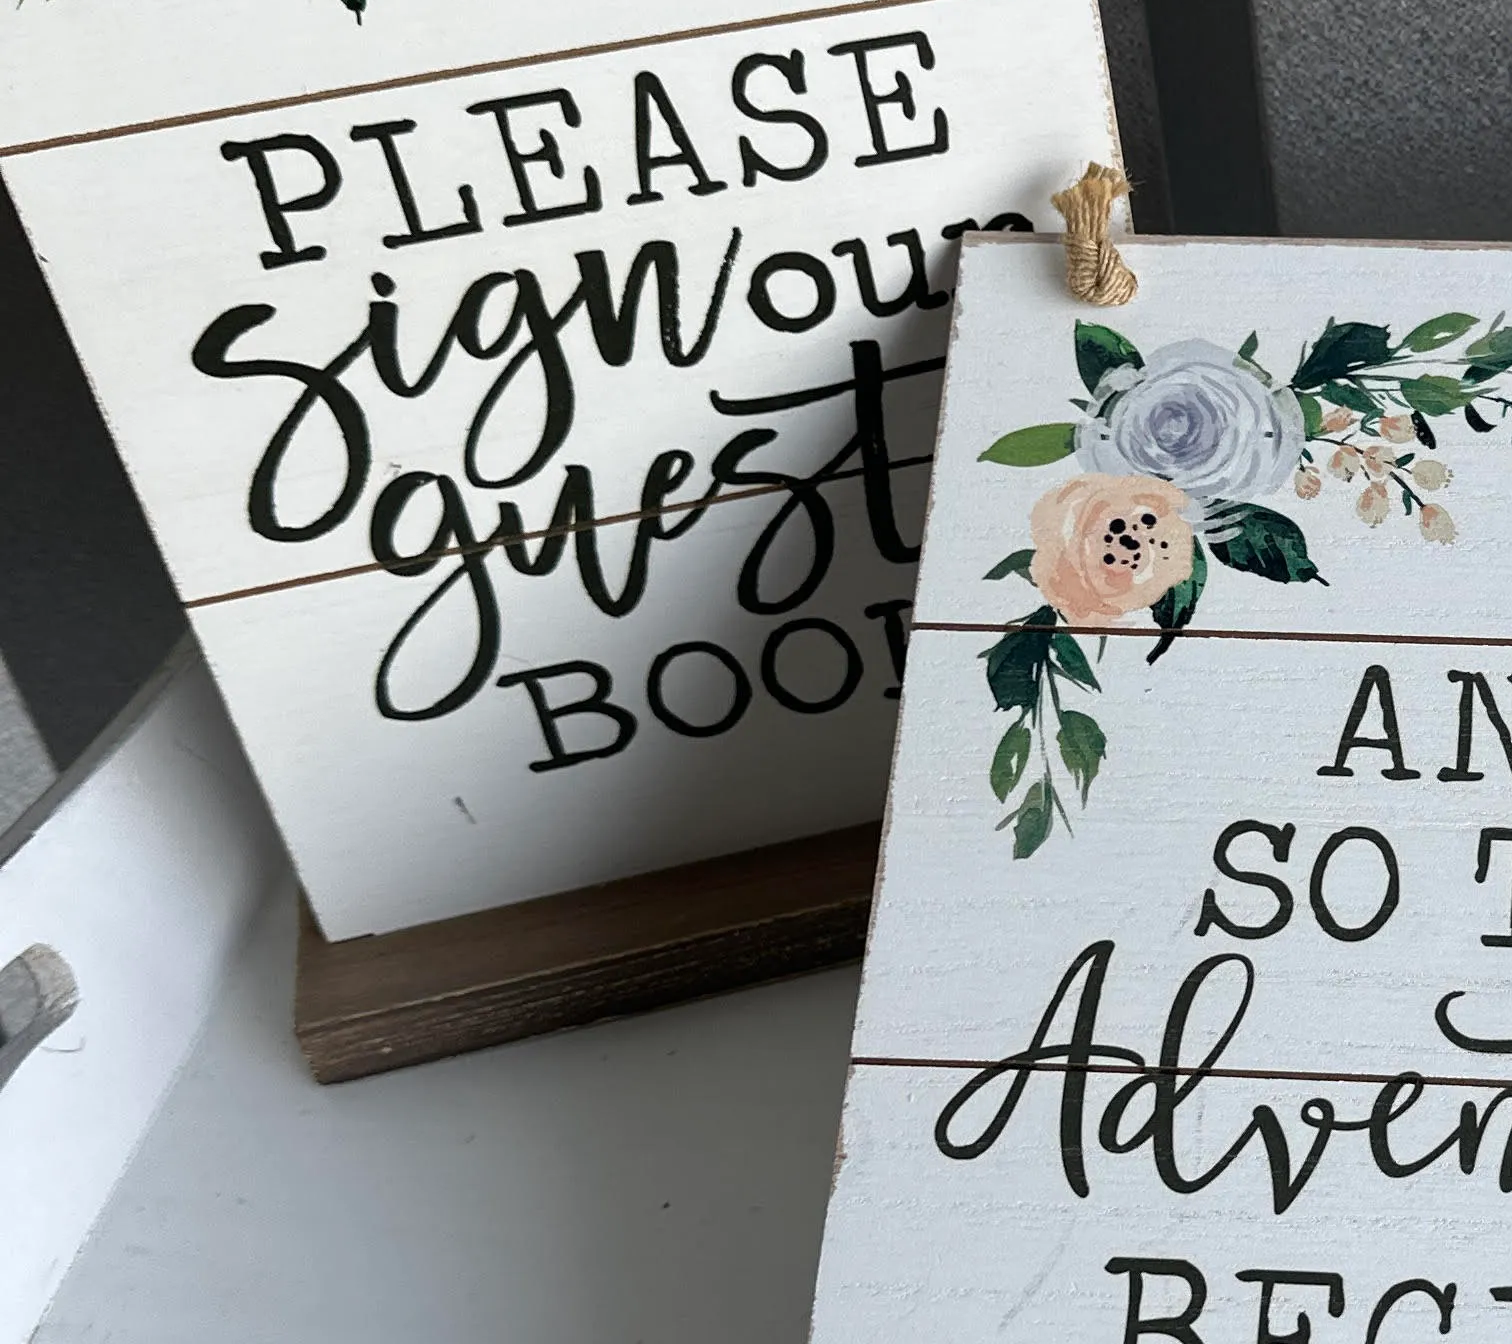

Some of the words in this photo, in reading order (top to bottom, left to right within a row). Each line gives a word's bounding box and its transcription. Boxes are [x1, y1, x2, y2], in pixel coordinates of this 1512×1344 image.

[221, 30, 950, 271] PLEASE
[191, 226, 743, 542] sign
[369, 340, 947, 722] guest
[1194, 819, 1401, 943] SO
